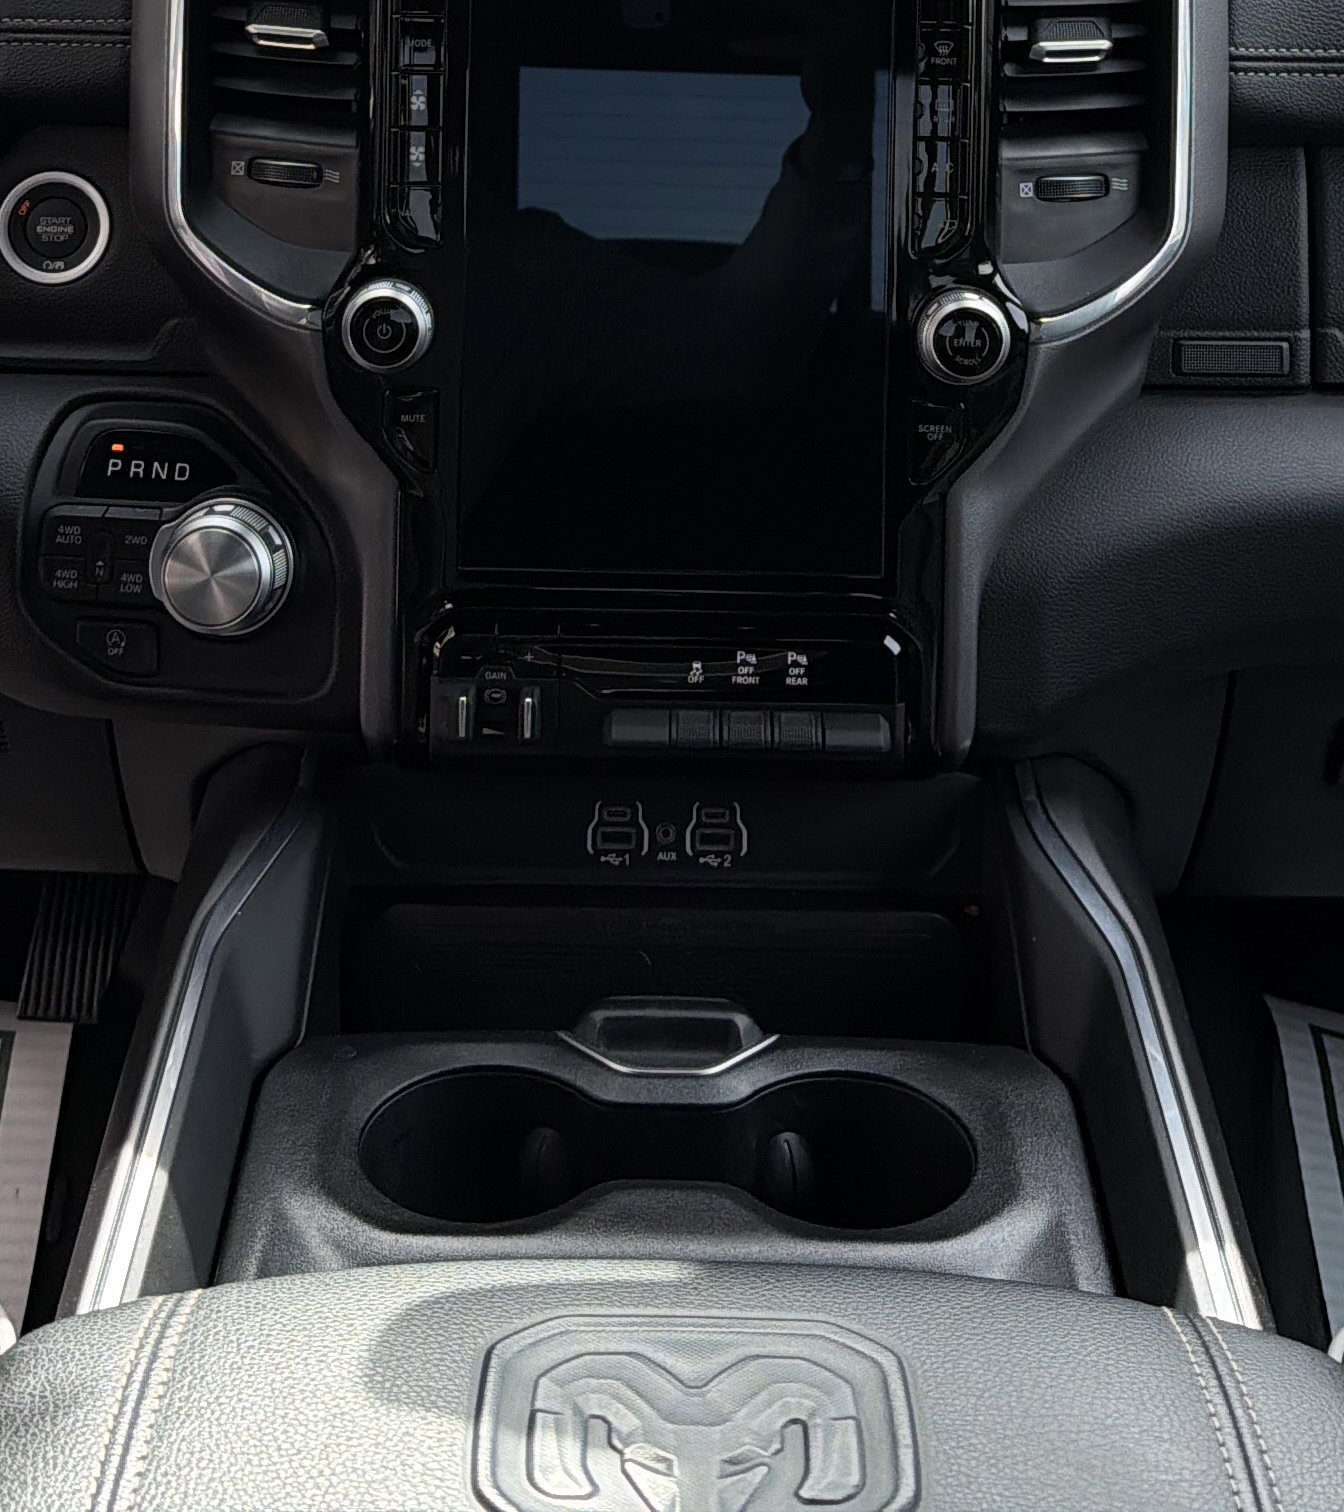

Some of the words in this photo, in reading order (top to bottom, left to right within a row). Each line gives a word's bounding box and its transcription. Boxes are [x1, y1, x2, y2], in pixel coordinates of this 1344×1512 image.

[930, 56, 958, 66] FRONT
[39, 216, 72, 225] START
[36, 225, 74, 234] ENGINE
[41, 234, 69, 242] STOP
[953, 338, 981, 348] ENTER
[400, 414, 426, 423] MUTE
[918, 424, 952, 433] SCREEN
[926, 433, 943, 441] OFF
[57, 525, 81, 535] 4WD
[55, 535, 82, 545] AUTO
[124, 534, 148, 545] 2WD
[55, 569, 78, 579] 4WD
[95, 567, 104, 576] N
[120, 573, 143, 584] 4WD
[53, 579, 79, 589] HIGH
[120, 583, 142, 593] LOW
[107, 647, 125, 656] OFF
[737, 666, 755, 675] OFF
[788, 667, 805, 676] OFF
[484, 671, 507, 681] GAIN
[687, 675, 705, 684] OFF
[731, 675, 761, 685] FRONT
[785, 676, 808, 686] REAR
[622, 854, 631, 866] 1
[656, 851, 677, 862] AUX
[723, 855, 732, 867] 2
